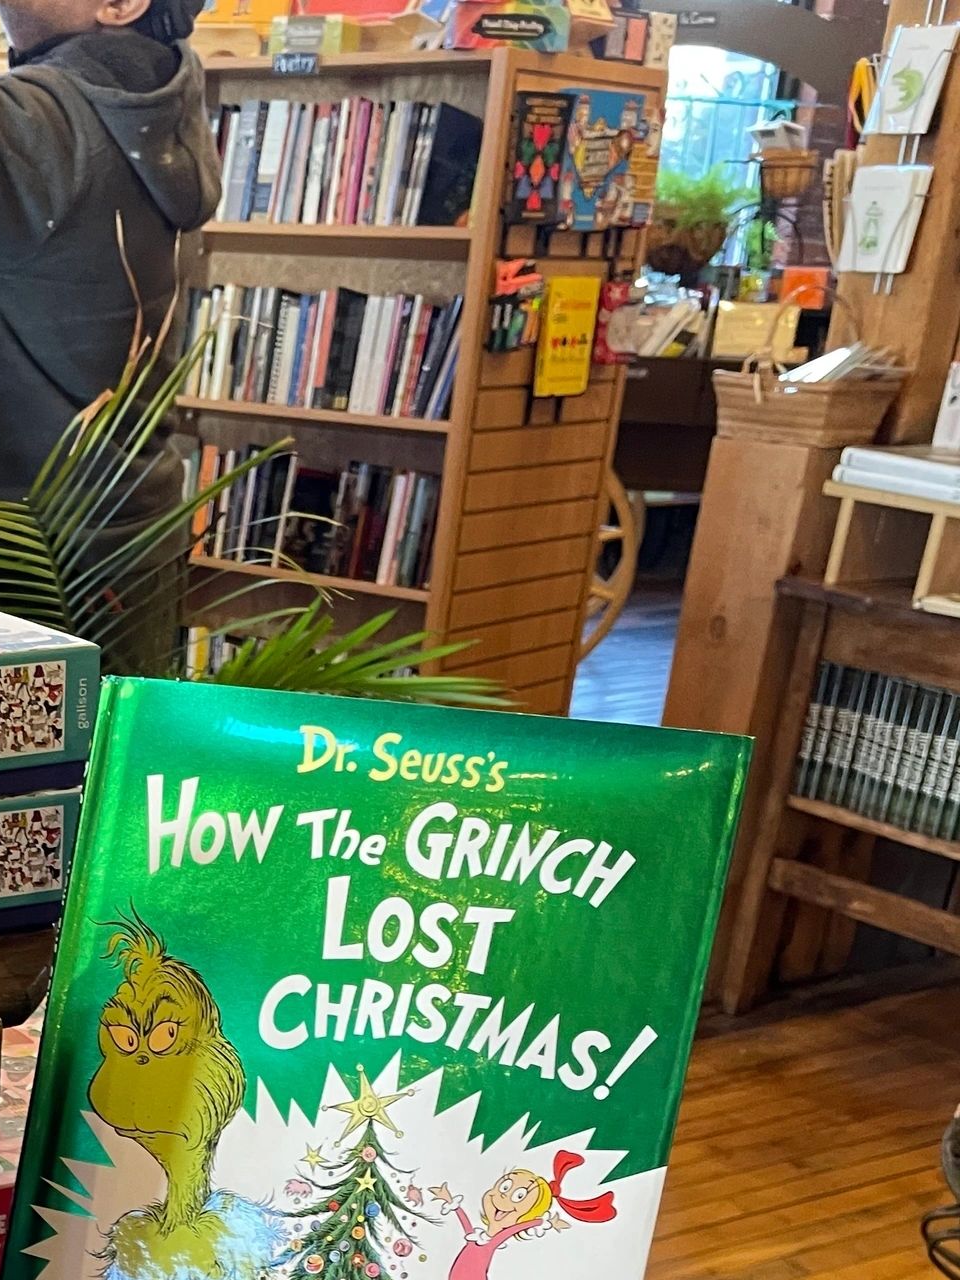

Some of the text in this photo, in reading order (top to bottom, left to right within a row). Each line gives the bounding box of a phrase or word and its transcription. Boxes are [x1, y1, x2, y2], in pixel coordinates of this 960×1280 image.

[297, 725, 510, 793] Dr. Seuss's
[297, 808, 388, 867] The
[404, 801, 637, 908] GRINCH
[321, 875, 516, 975] LOST
[258, 974, 659, 1101] CHRISTMAS!
